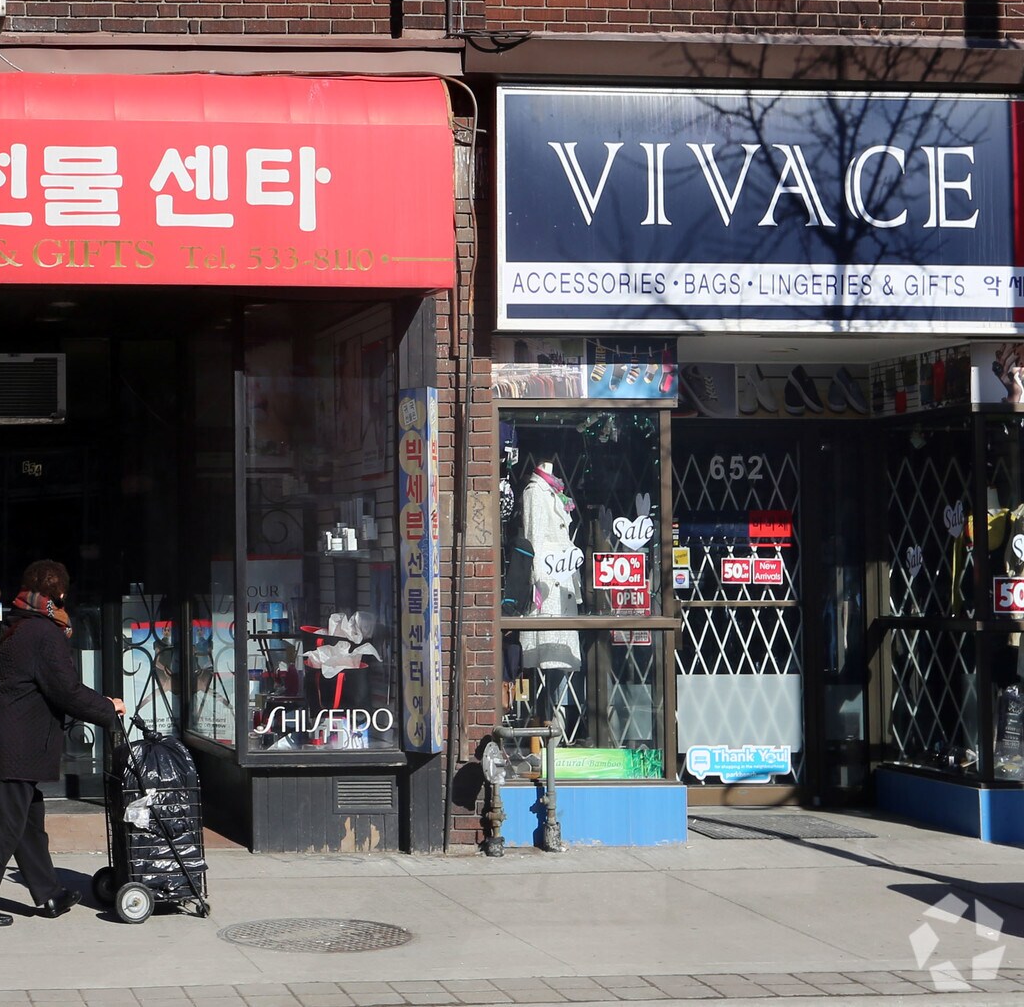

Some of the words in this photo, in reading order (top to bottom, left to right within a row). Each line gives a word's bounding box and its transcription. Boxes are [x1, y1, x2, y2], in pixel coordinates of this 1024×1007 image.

[547, 141, 979, 229] VIVACE
[32, 239, 156, 269] GIFTS
[180, 244, 236, 270] Tel.
[247, 247, 374, 272] 533-8110
[512, 272, 666, 295] ACCESSORIES
[684, 272, 741, 295] BAGS
[759, 273, 873, 296] LINGERIES
[882, 275, 894, 296] &
[904, 274, 965, 297] GIFTS
[23, 461, 41, 475] 654
[709, 456, 764, 480] 652
[614, 516, 655, 542] Sale
[544, 548, 584, 575] Sale
[759, 562, 776, 570] New
[616, 592, 644, 606] OPEN
[254, 706, 393, 734] SHISEIDO
[555, 758, 585, 767] atural
[588, 759, 622, 768] Bamboo
[713, 749, 755, 762] Thank
[758, 749, 788, 763] You!
